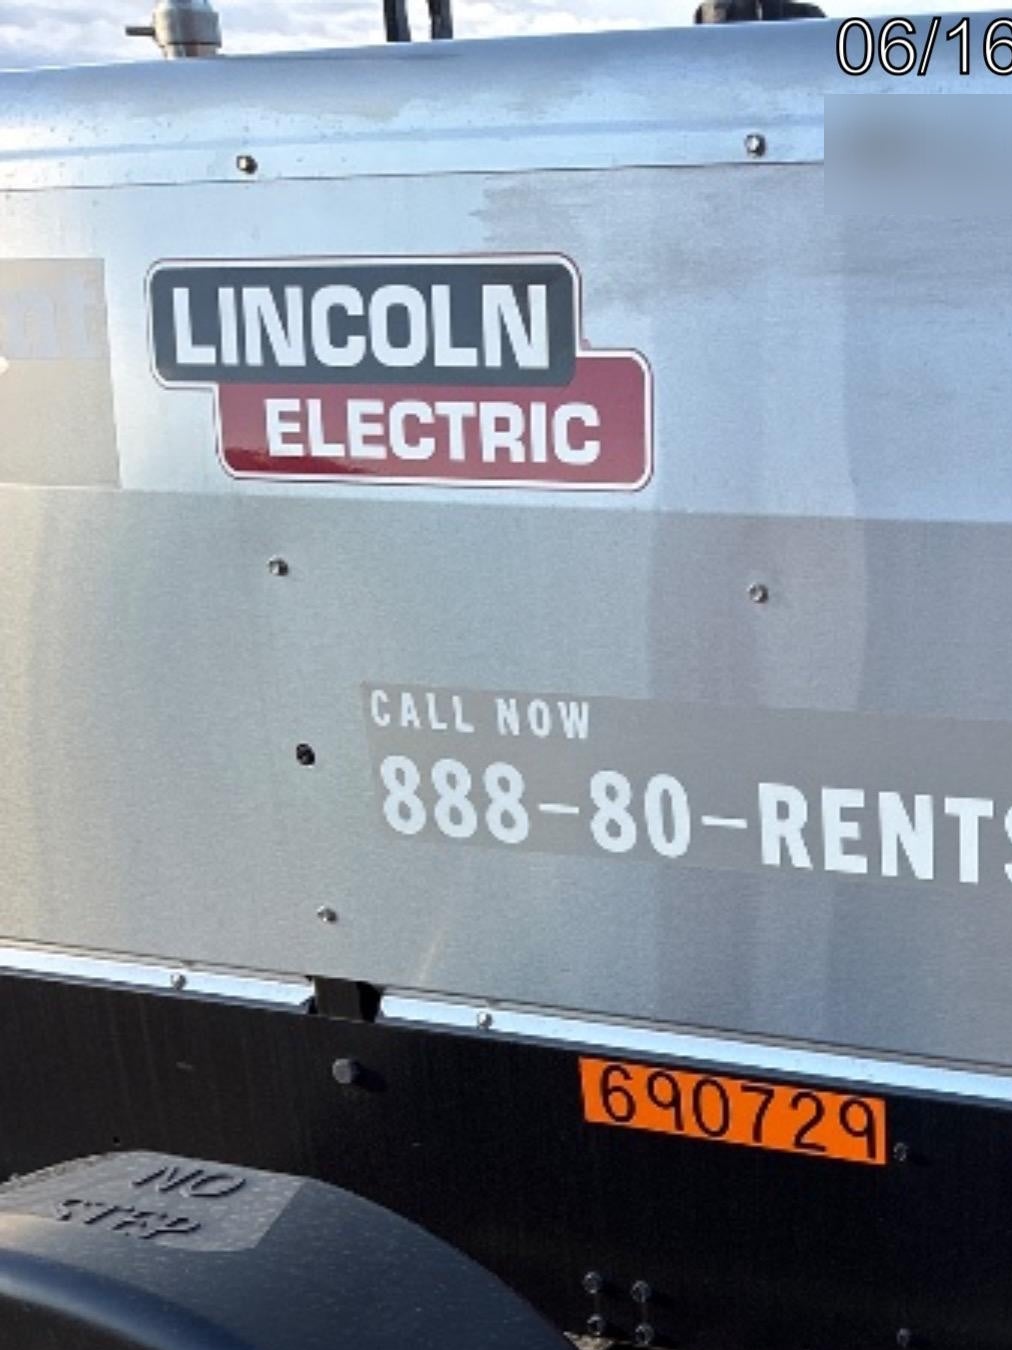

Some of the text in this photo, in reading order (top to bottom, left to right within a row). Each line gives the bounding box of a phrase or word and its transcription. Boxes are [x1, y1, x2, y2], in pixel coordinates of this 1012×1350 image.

[172, 283, 550, 370] LINCOLN
[264, 398, 601, 466] ELECTRIC
[370, 689, 590, 740] CALL NOW
[601, 1064, 877, 1160] 690729
[131, 1166, 247, 1198] NO
[56, 1199, 201, 1240] STEP
